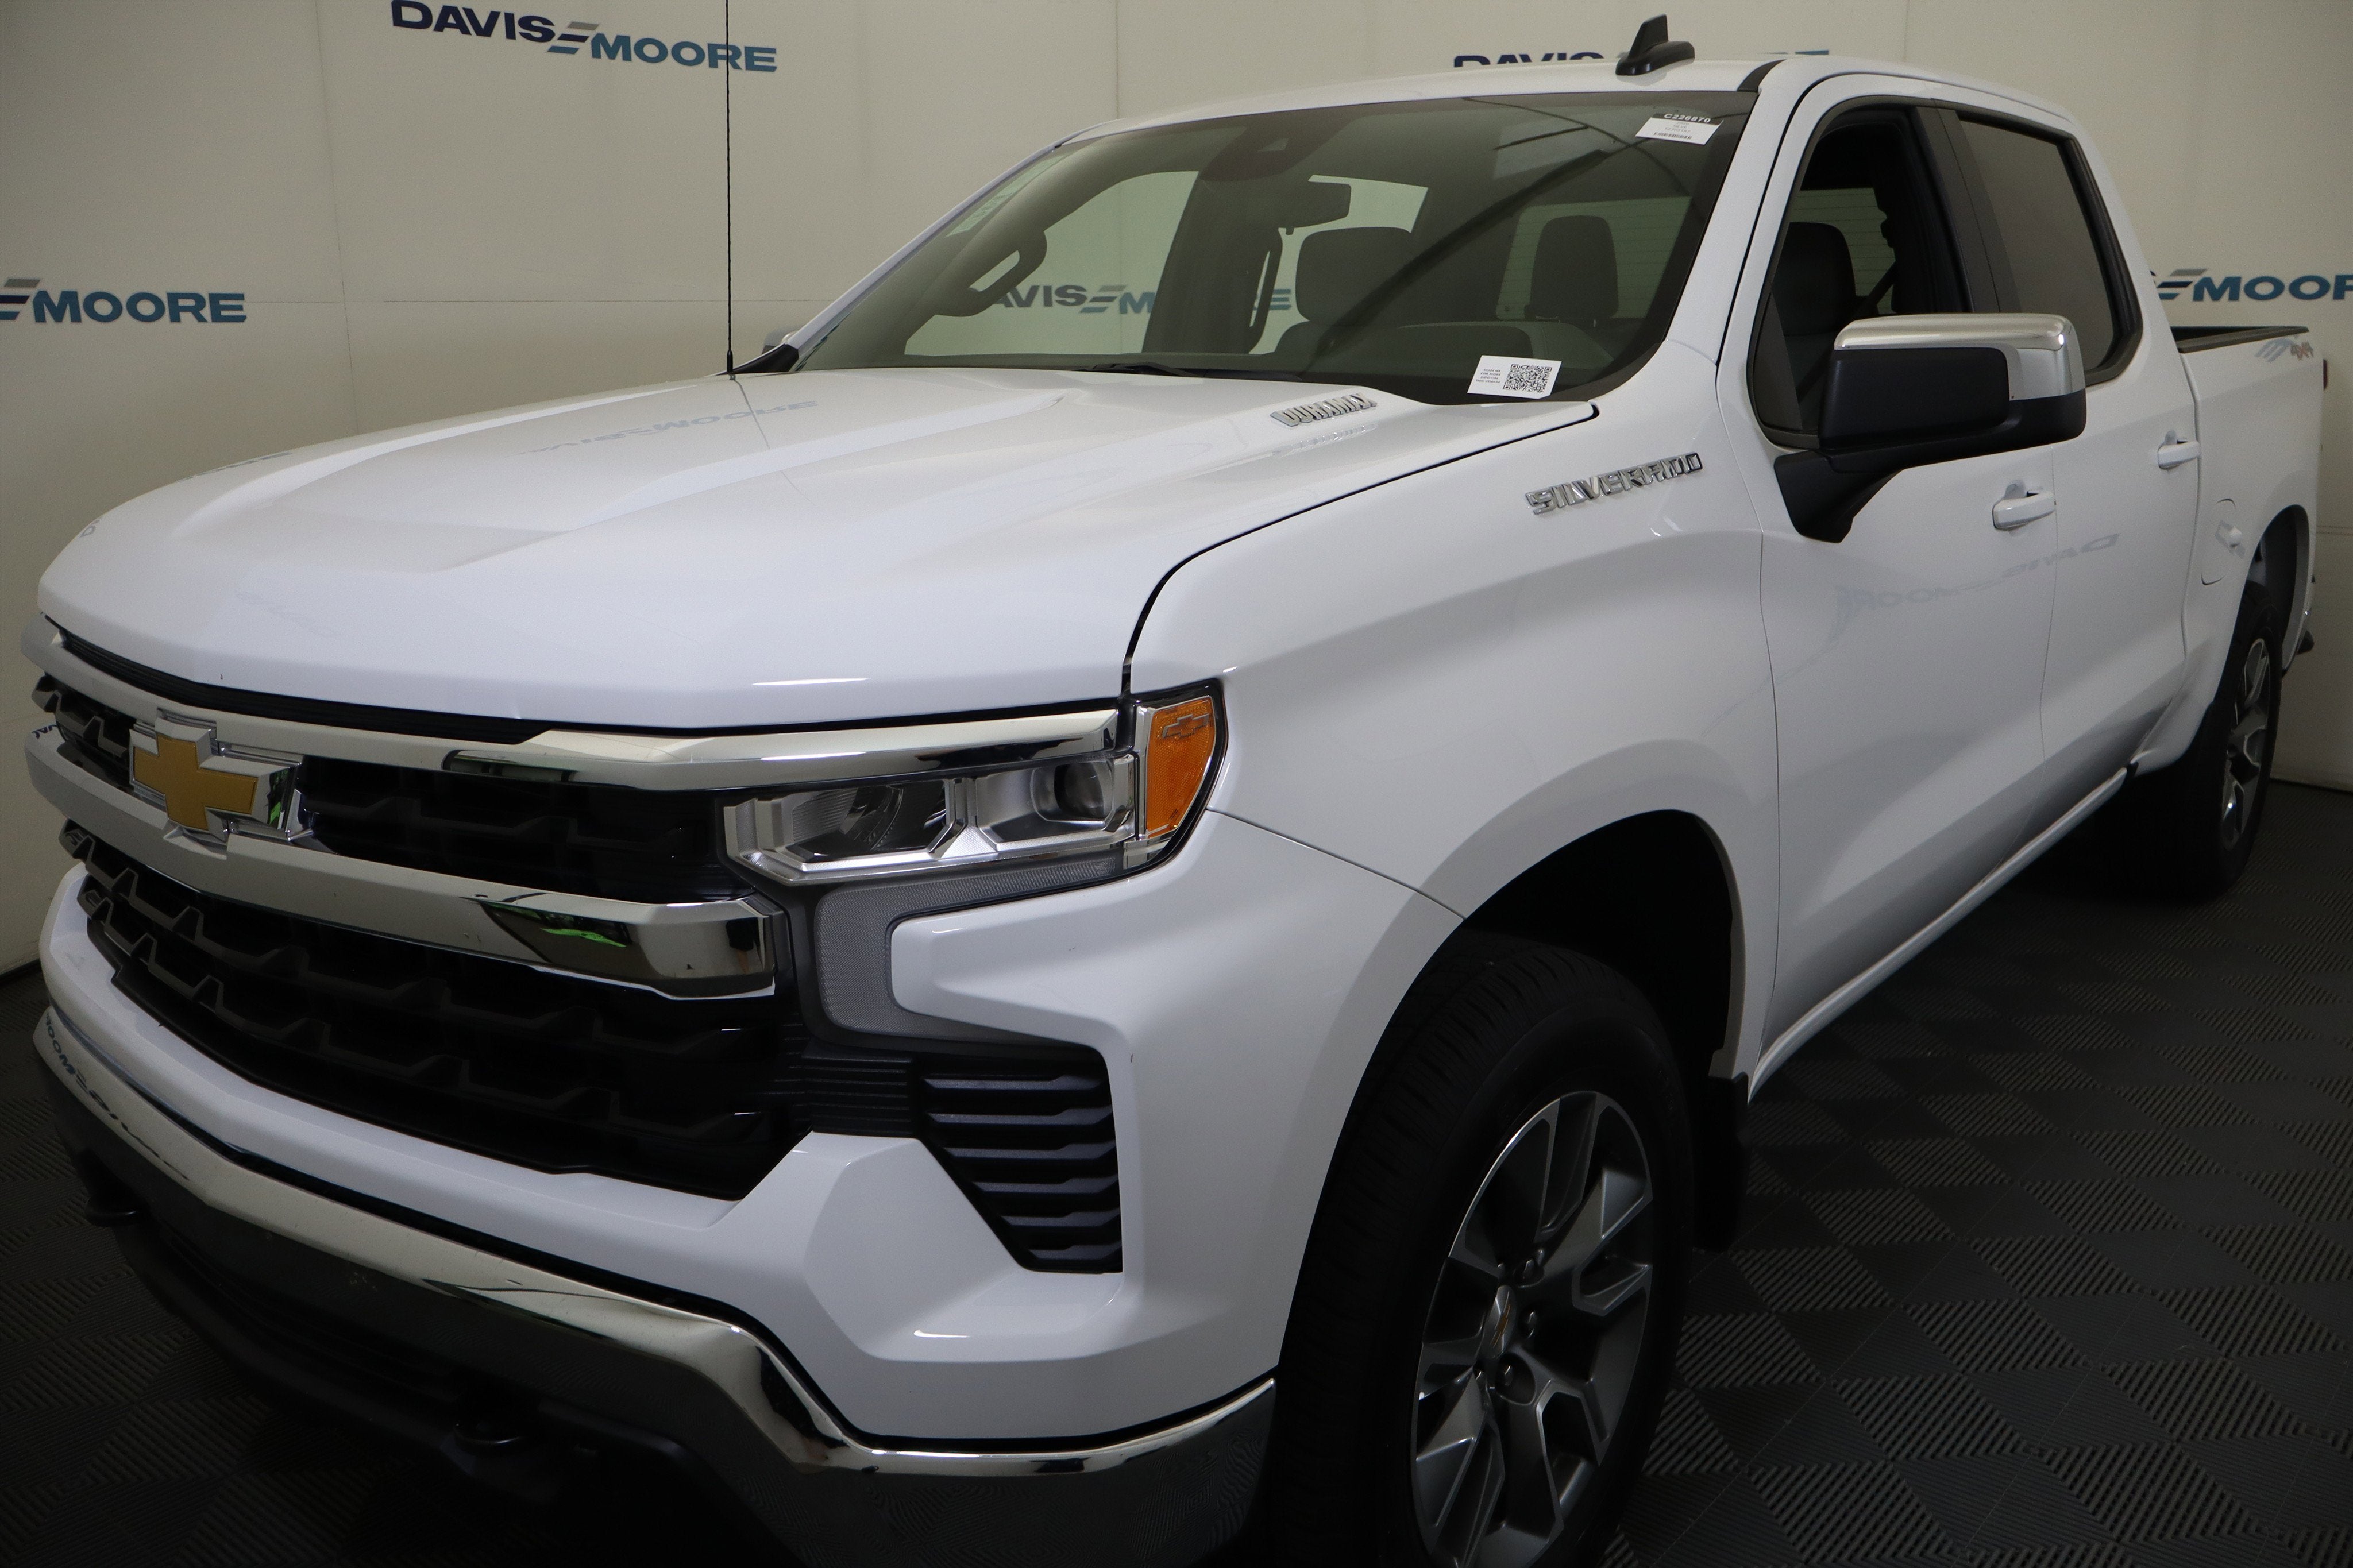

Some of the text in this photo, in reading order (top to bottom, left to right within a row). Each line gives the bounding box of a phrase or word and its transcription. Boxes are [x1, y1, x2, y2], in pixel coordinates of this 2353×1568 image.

[391, 0, 777, 72] DAVIS MOORE
[32, 290, 247, 323] MOORE
[993, 285, 1087, 308] AVIS
[1525, 451, 1703, 515] SILVERADO
